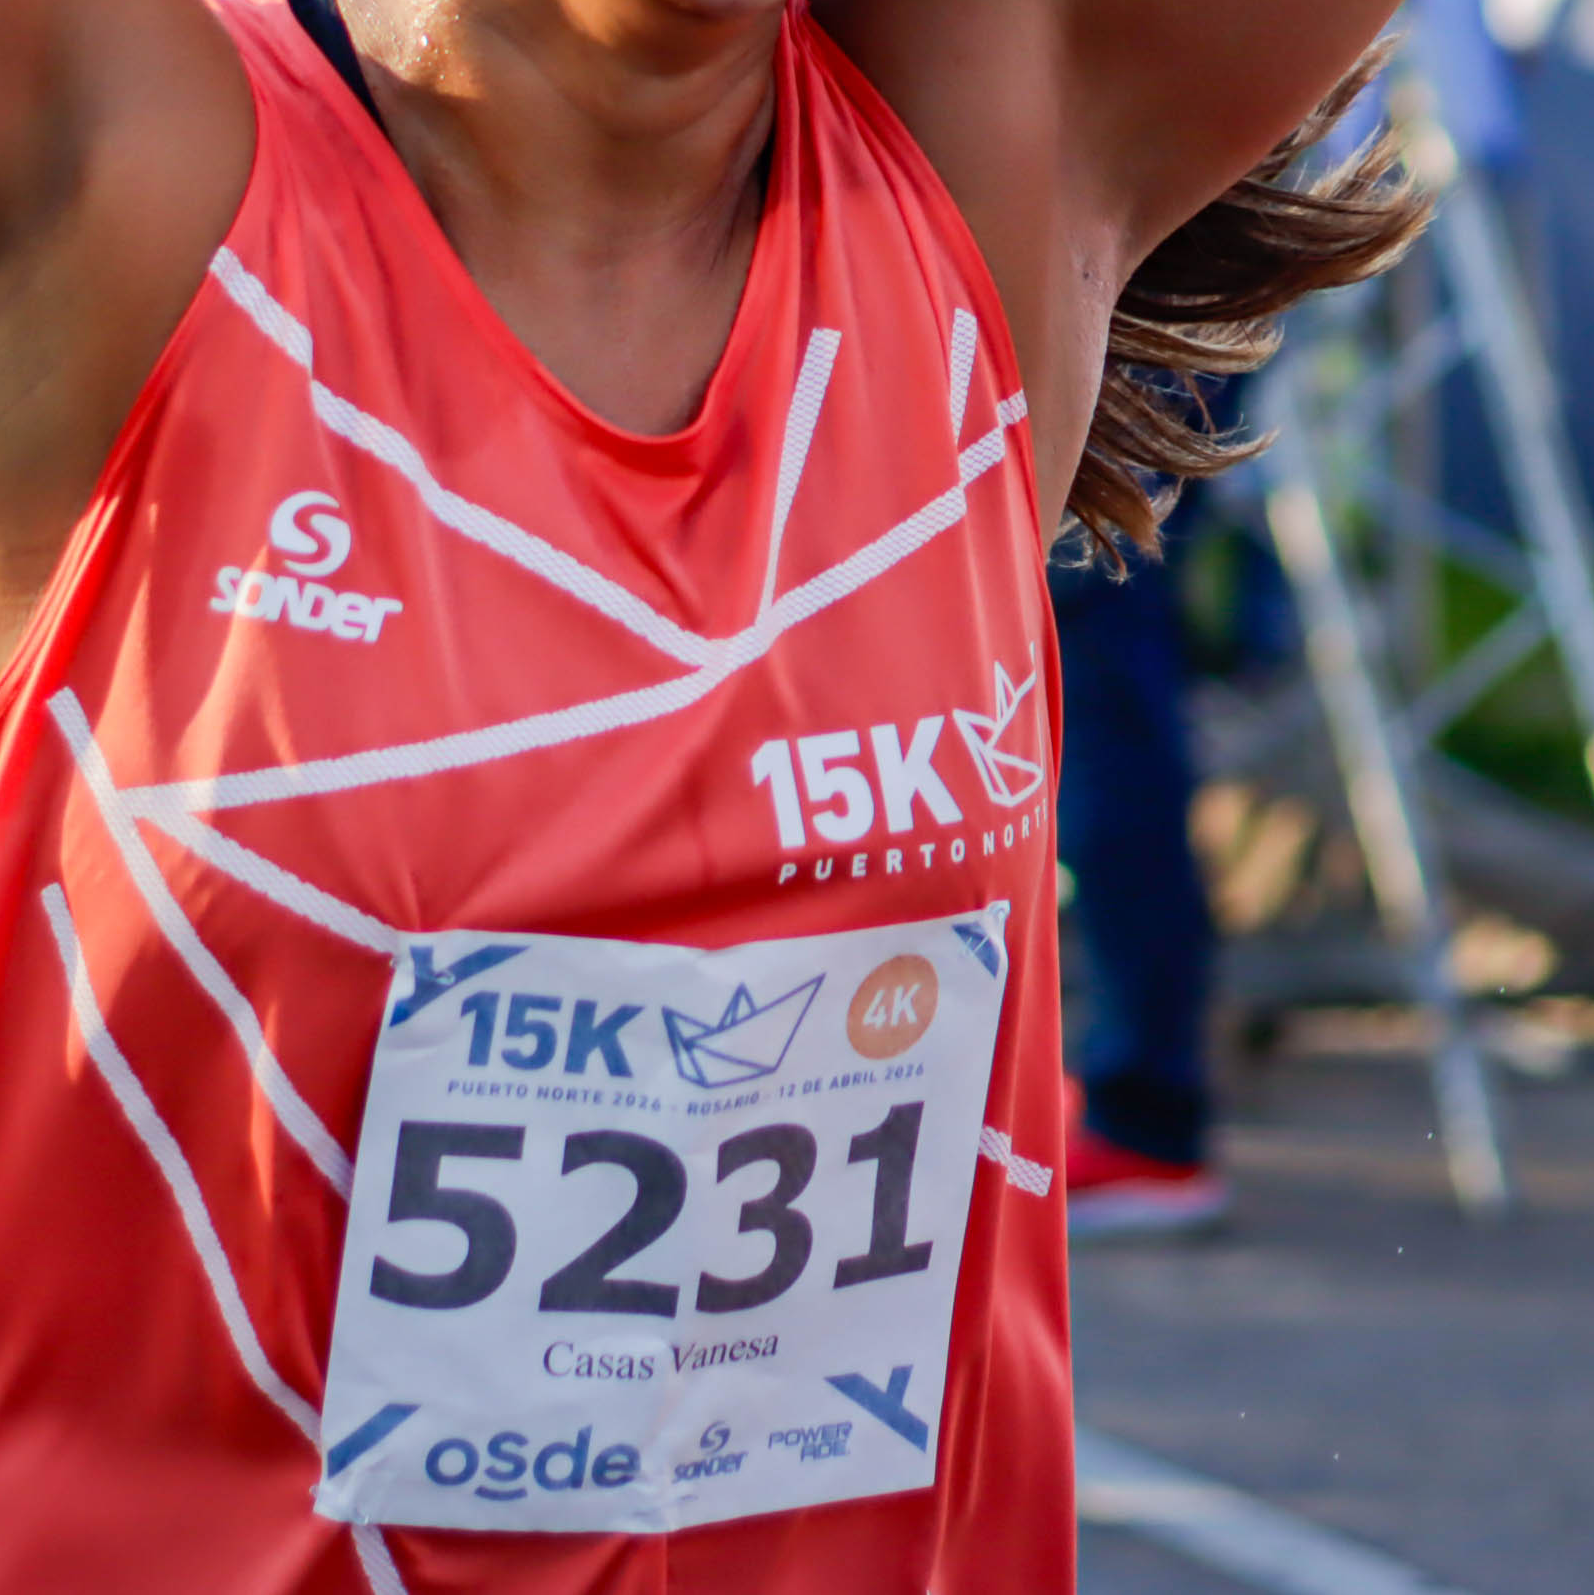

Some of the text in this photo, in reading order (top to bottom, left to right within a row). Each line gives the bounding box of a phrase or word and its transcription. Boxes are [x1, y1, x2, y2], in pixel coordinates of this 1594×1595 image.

[750, 714, 964, 850] 15K
[778, 838, 966, 885] PUERTO
[459, 989, 645, 1078] 15K
[862, 981, 922, 1031] 4K
[447, 1061, 925, 1117] PUERTO NORTE 2026 ROSARIO 12 DE ABRIL 2026
[368, 1099, 934, 1319] 5231
[543, 1335, 780, 1382] Casas Vanesa
[424, 1423, 641, 1502] osde
[768, 1421, 853, 1451] POWER
